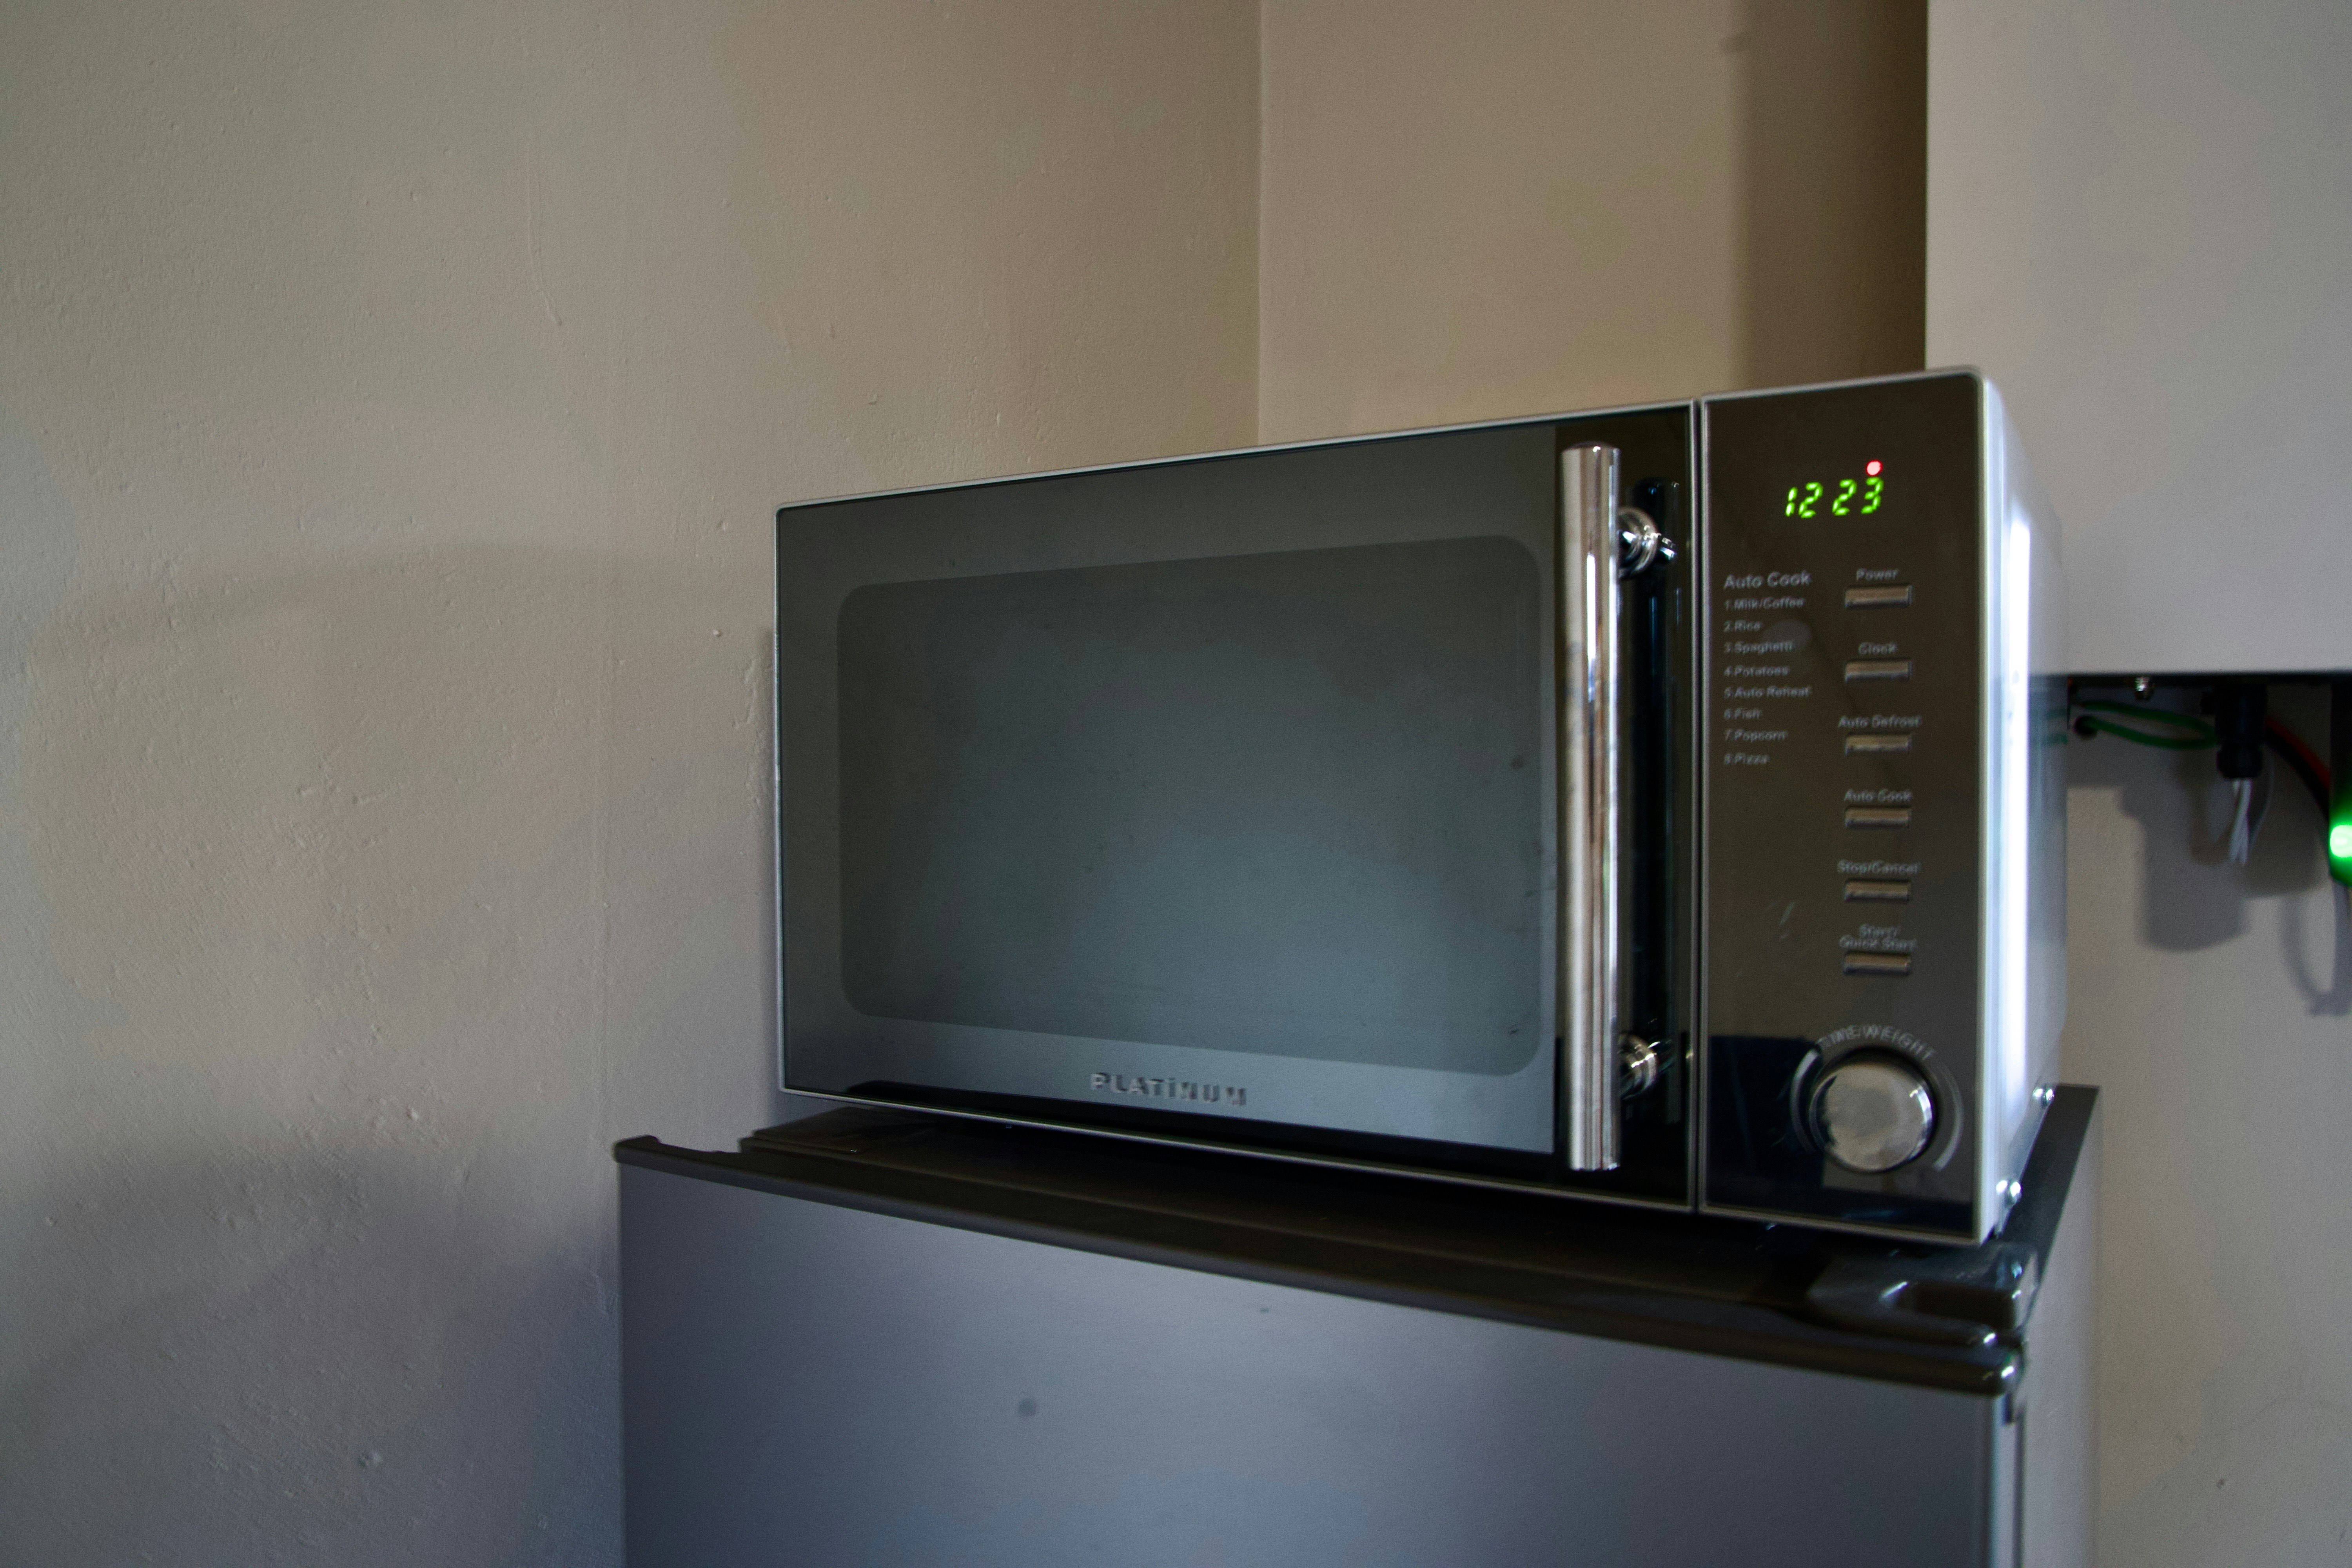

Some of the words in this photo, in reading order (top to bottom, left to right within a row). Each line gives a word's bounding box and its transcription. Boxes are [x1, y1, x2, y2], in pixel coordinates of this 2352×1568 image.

[1724, 574, 1764, 589] Auto
[1766, 570, 1812, 587] Cook
[1856, 568, 1899, 581] Power
[1838, 715, 1869, 728] Auto
[1871, 714, 1922, 728] Defrost
[1844, 788, 1877, 802] Auto
[1877, 788, 1913, 802] Cook
